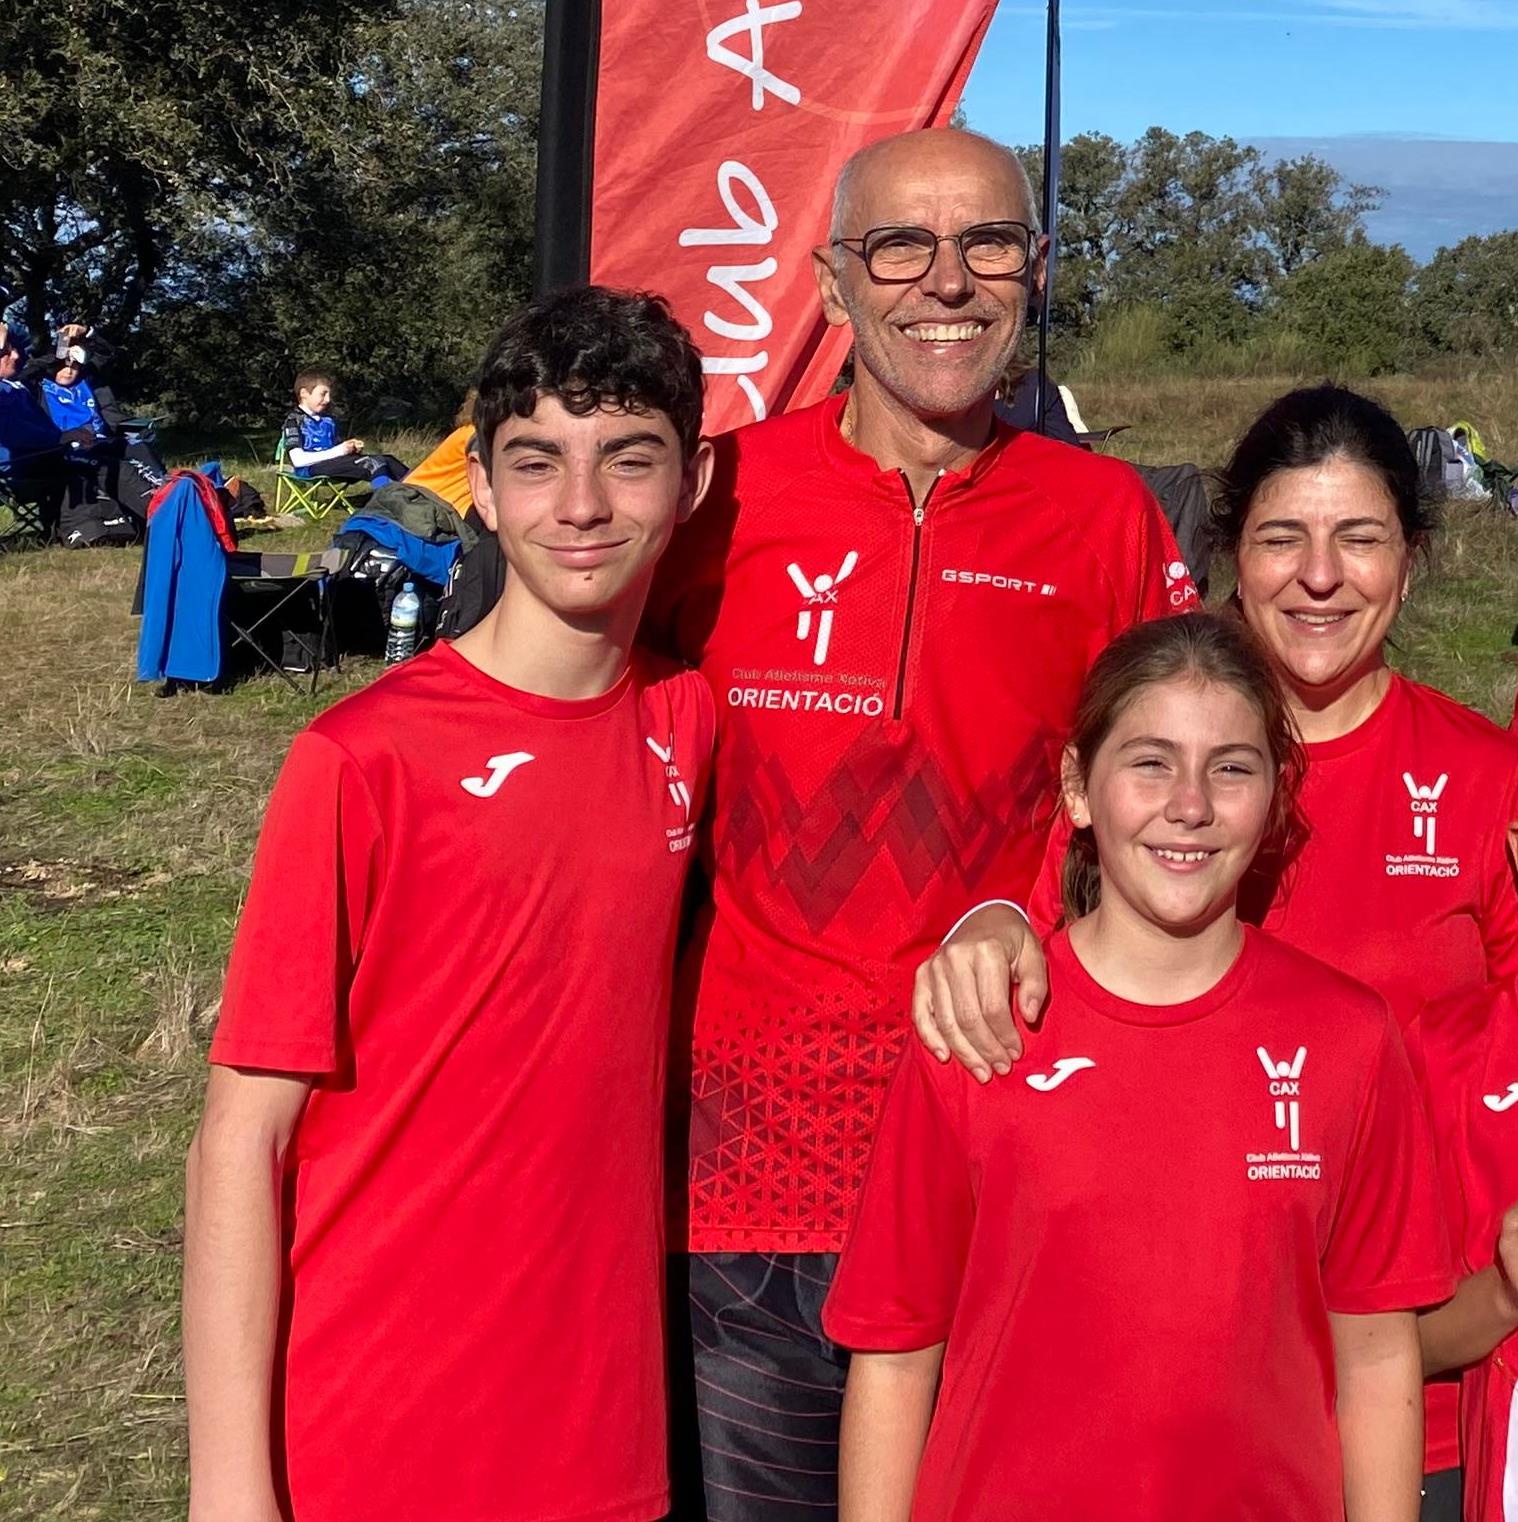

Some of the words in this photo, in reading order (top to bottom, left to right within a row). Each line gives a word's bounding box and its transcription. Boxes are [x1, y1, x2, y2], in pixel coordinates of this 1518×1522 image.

[941, 568, 1036, 593] GSPORT
[806, 590, 838, 605] AX
[1169, 584, 1198, 606] CA
[728, 687, 884, 716] ORIENTACIÓ
[1410, 801, 1438, 813] CAX
[1386, 863, 1460, 877] ORIENTACIÓ
[1269, 1082, 1300, 1096] CAX
[1247, 1163, 1321, 1180] ORIENTACIÓ
